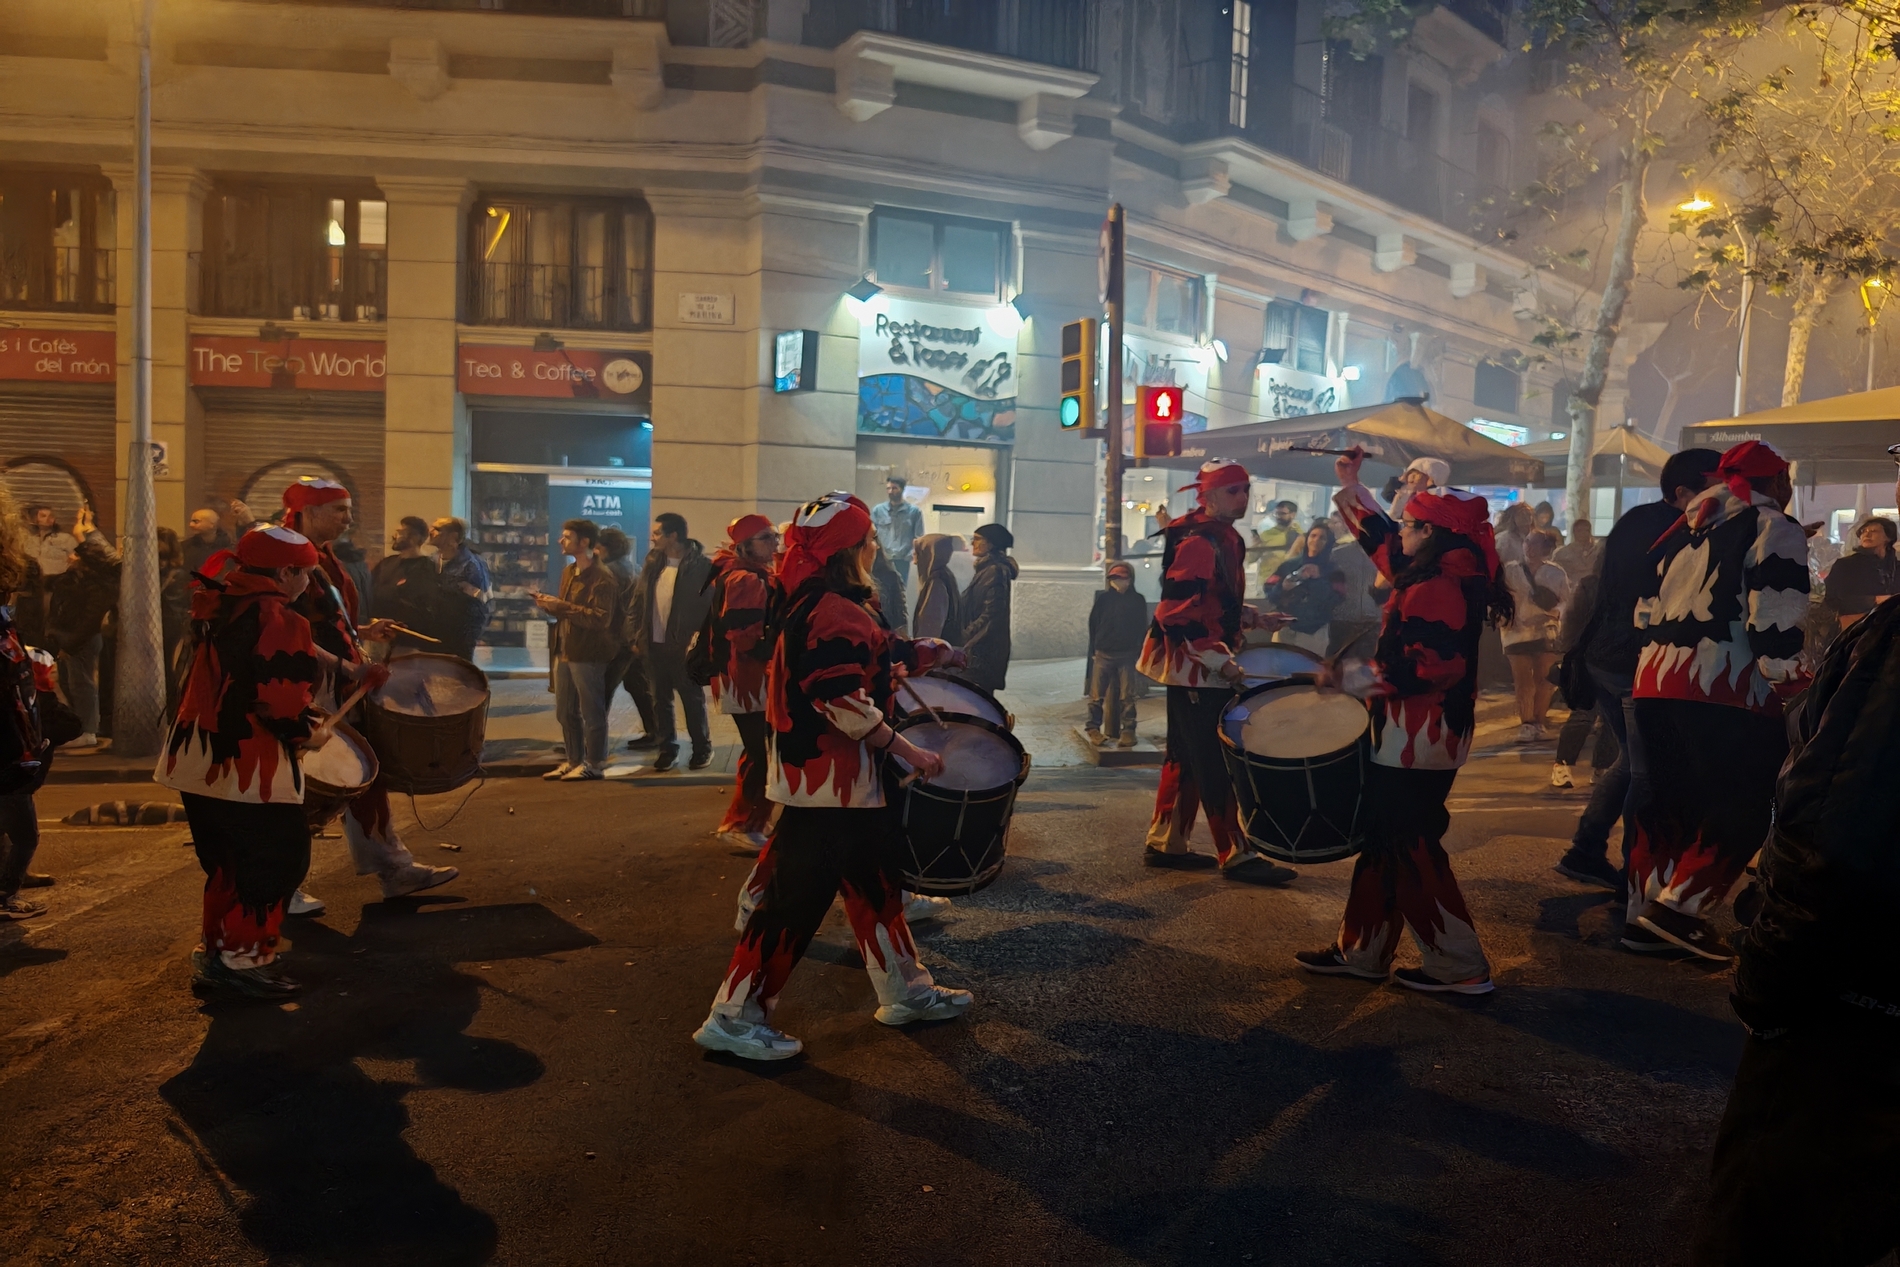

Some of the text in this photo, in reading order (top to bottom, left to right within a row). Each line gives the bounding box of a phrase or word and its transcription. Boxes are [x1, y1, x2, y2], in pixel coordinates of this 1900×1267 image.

[16, 337, 21, 352] i
[29, 338, 78, 354] Cafès
[35, 358, 110, 374] del món
[193, 347, 386, 378] The Tea World
[465, 359, 502, 378] Tea
[511, 361, 526, 379] &
[534, 361, 597, 382] Coffee
[583, 494, 622, 509] ATM
